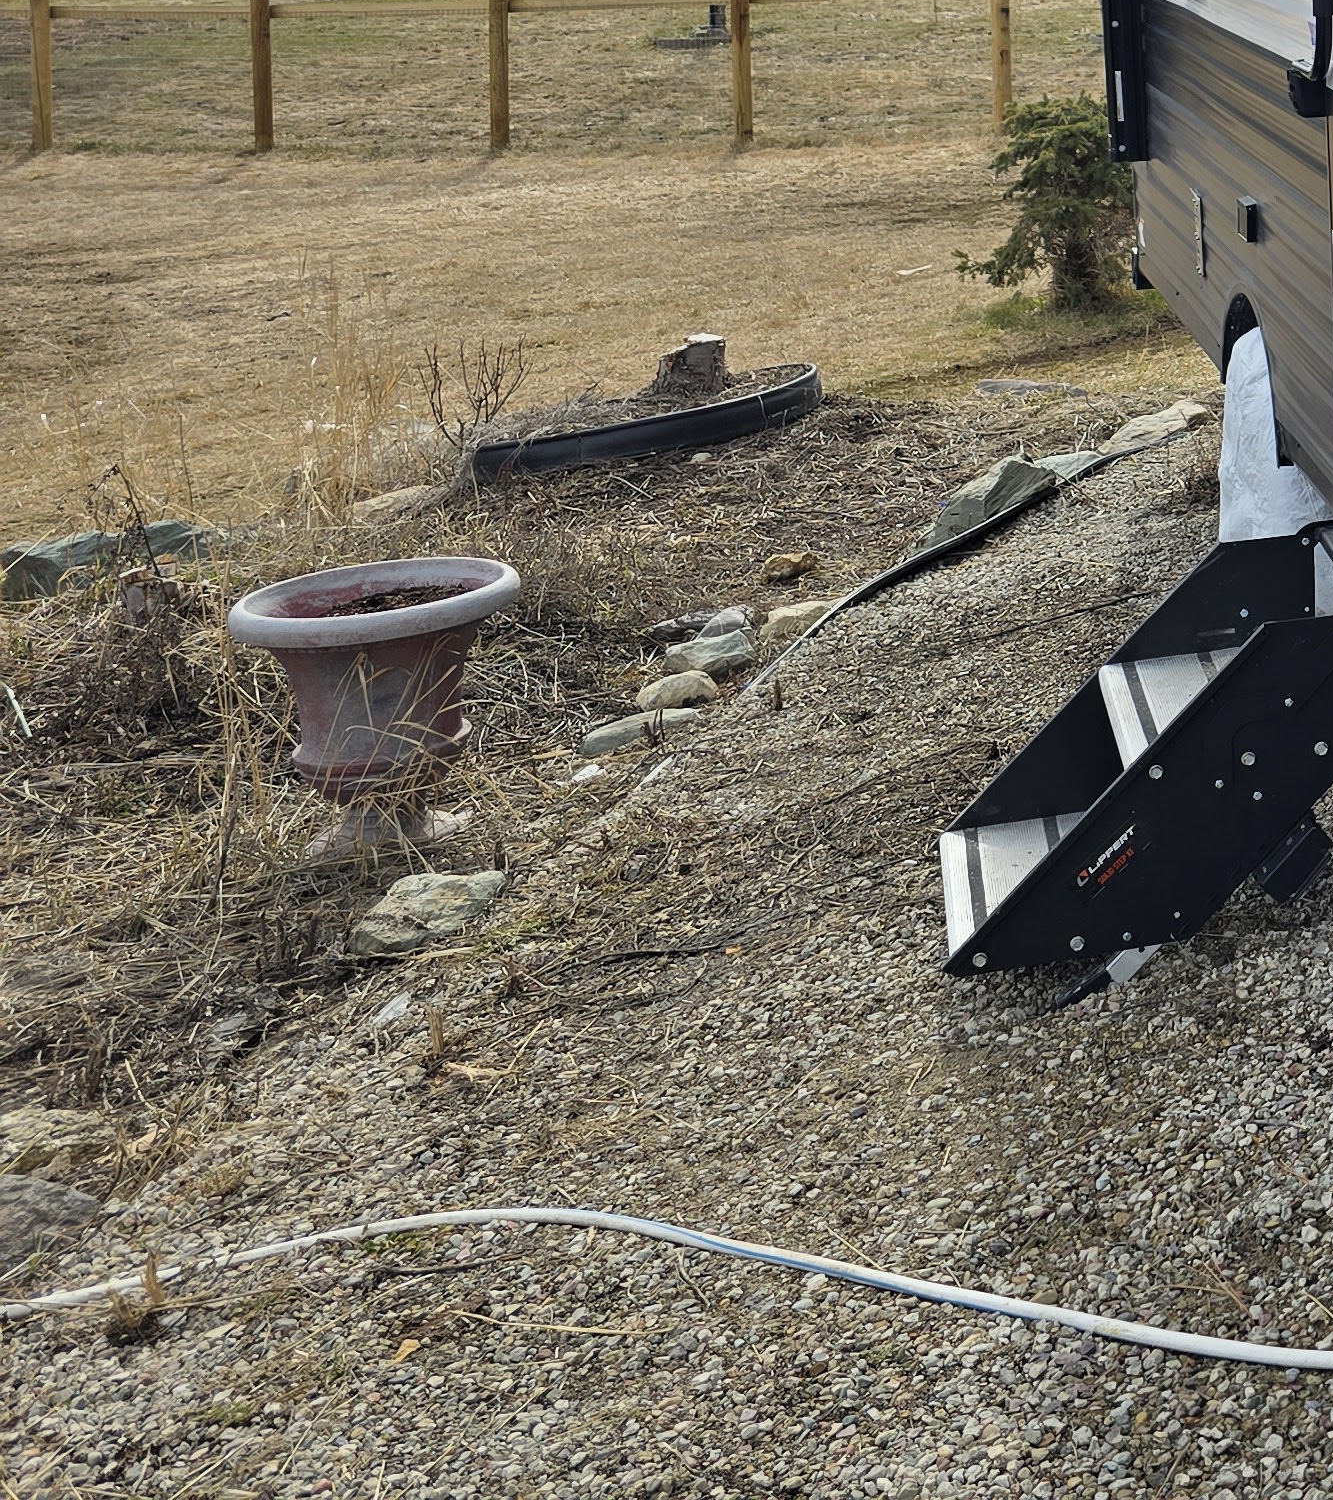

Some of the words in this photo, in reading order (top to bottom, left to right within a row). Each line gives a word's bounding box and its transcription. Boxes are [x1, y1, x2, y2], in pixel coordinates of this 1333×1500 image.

[1088, 823, 1136, 874] LIPPERT
[1097, 866, 1115, 885] SOLID
[1112, 854, 1127, 870] STEP
